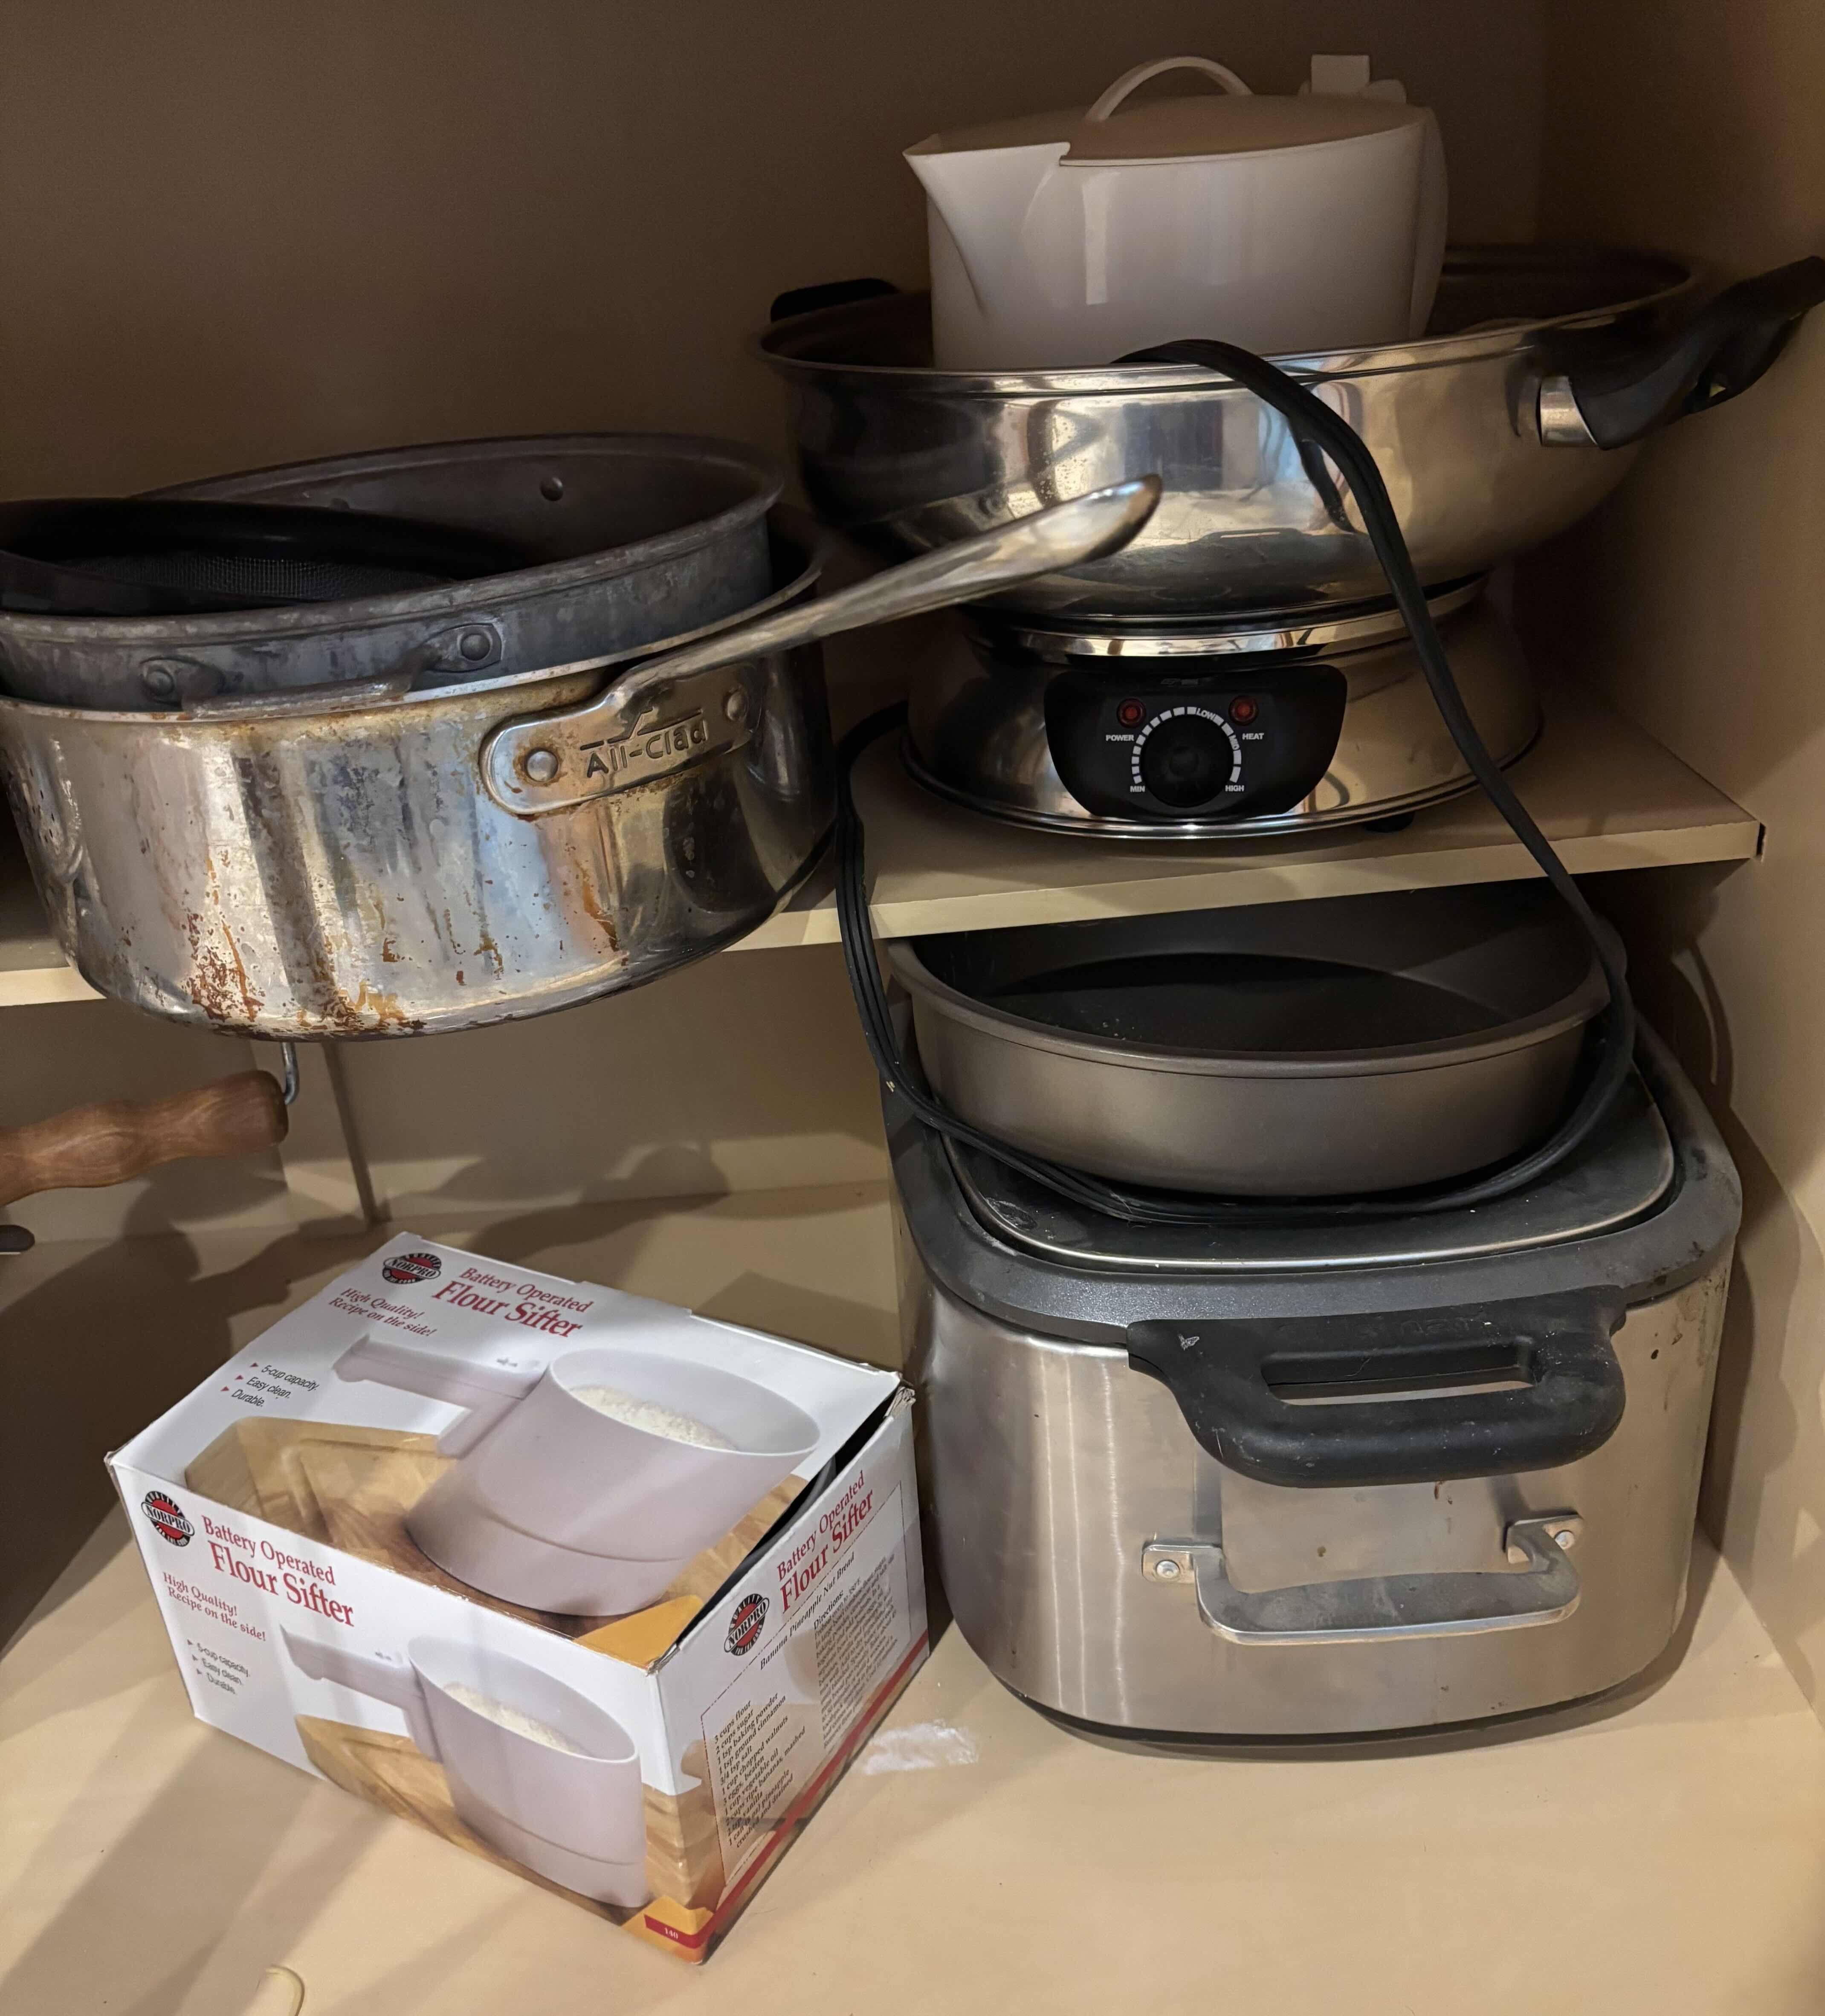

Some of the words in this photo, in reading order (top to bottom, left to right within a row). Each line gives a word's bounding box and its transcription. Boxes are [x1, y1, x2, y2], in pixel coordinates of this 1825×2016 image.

[1196, 708, 1216, 721] LOW
[1242, 732, 1264, 740] HEAT
[586, 719, 707, 778] All-Clad
[388, 1258, 436, 1277] NORPRO
[459, 1267, 516, 1293] Battery
[516, 1283, 594, 1313] Operated
[328, 1297, 368, 1315] Recipe
[367, 1310, 385, 1321] on
[383, 1316, 405, 1327] the
[403, 1323, 437, 1337] side!
[340, 1287, 371, 1303] High
[370, 1297, 425, 1320] Quality!
[431, 1280, 511, 1316] Flour
[504, 1302, 583, 1338] Sifter
[246, 1377, 269, 1391] Easy
[261, 1365, 286, 1379] 5-cup
[146, 1504, 191, 1533] NORPRO
[777, 1530, 817, 1582] Battery
[819, 1469, 864, 1534] Operated
[201, 1515, 256, 1558] Battery
[261, 1540, 336, 1586] Operated
[780, 1544, 828, 1614] Flour
[832, 1489, 873, 1554] Sifter
[163, 1572, 189, 1593] High
[191, 1586, 238, 1617] Quality!
[207, 1540, 279, 1596] Flour
[283, 1573, 354, 1627] Sifter
[168, 1585, 202, 1611] Recipe
[205, 1607, 218, 1620] on
[220, 1612, 238, 1628] the
[240, 1623, 266, 1642] side!
[728, 1601, 766, 1649] NORPRO
[760, 1636, 788, 1669] Banana
[790, 1595, 822, 1636] Pineapple
[823, 1576, 835, 1597] Nut
[837, 1552, 854, 1579] Bread
[814, 1591, 843, 1629] Directions:
[719, 1719, 735, 1738] cups
[735, 1701, 750, 1721] flour
[721, 1730, 736, 1749] cups
[736, 1709, 753, 1731] sugar
[722, 1745, 733, 1759] tsp
[733, 1720, 755, 1747] baking
[756, 1693, 778, 1724] powder
[724, 1756, 734, 1770] tsp
[735, 1728, 756, 1759] ground
[757, 1696, 786, 1731] cinnamon
[727, 1774, 738, 1790] cup
[739, 1741, 765, 1776] chopped
[765, 1717, 788, 1744] walnuts
[730, 1760, 740, 1774] tsp
[741, 1745, 752, 1762] salt
[744, 1756, 765, 1781] beaten
[729, 1794, 741, 1811] cup
[770, 1747, 779, 1762] oil
